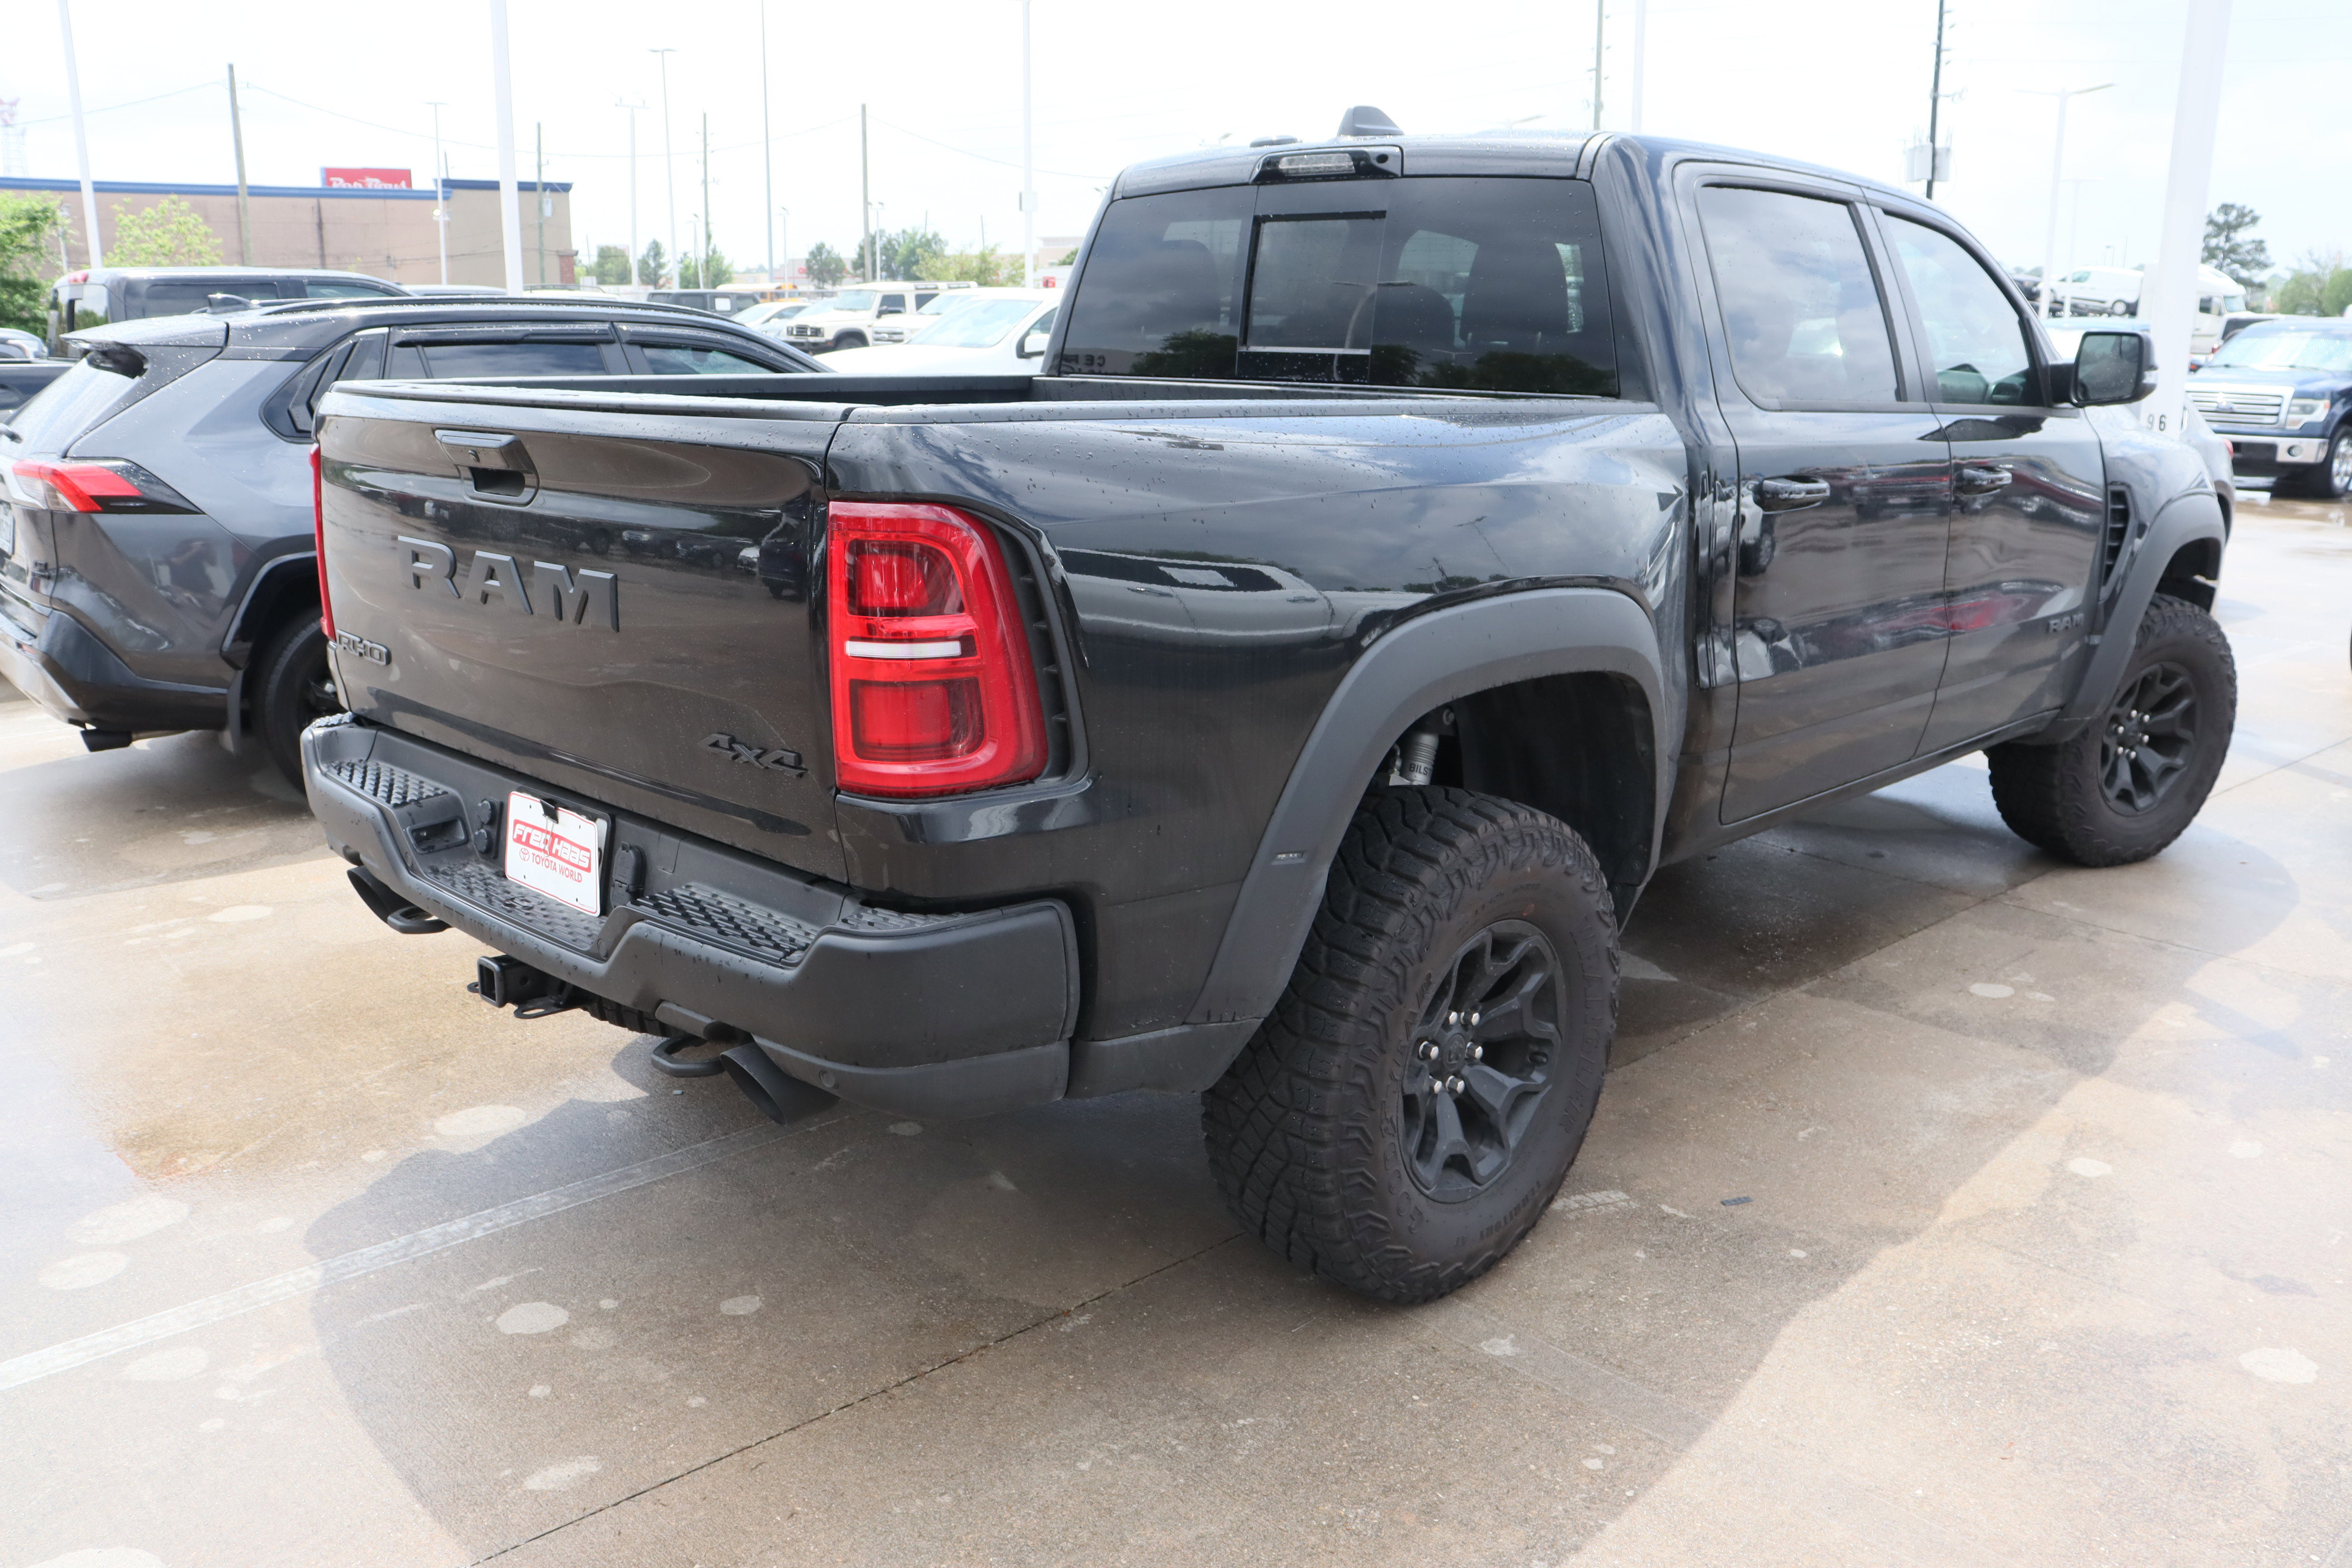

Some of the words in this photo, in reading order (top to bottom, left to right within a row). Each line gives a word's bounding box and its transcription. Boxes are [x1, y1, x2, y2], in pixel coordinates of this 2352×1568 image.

[397, 535, 620, 633] RAM
[2049, 613, 2085, 633] RAM
[337, 629, 391, 666] RHO
[532, 852, 557, 873] TOYOTA
[558, 863, 583, 883] WORLD
